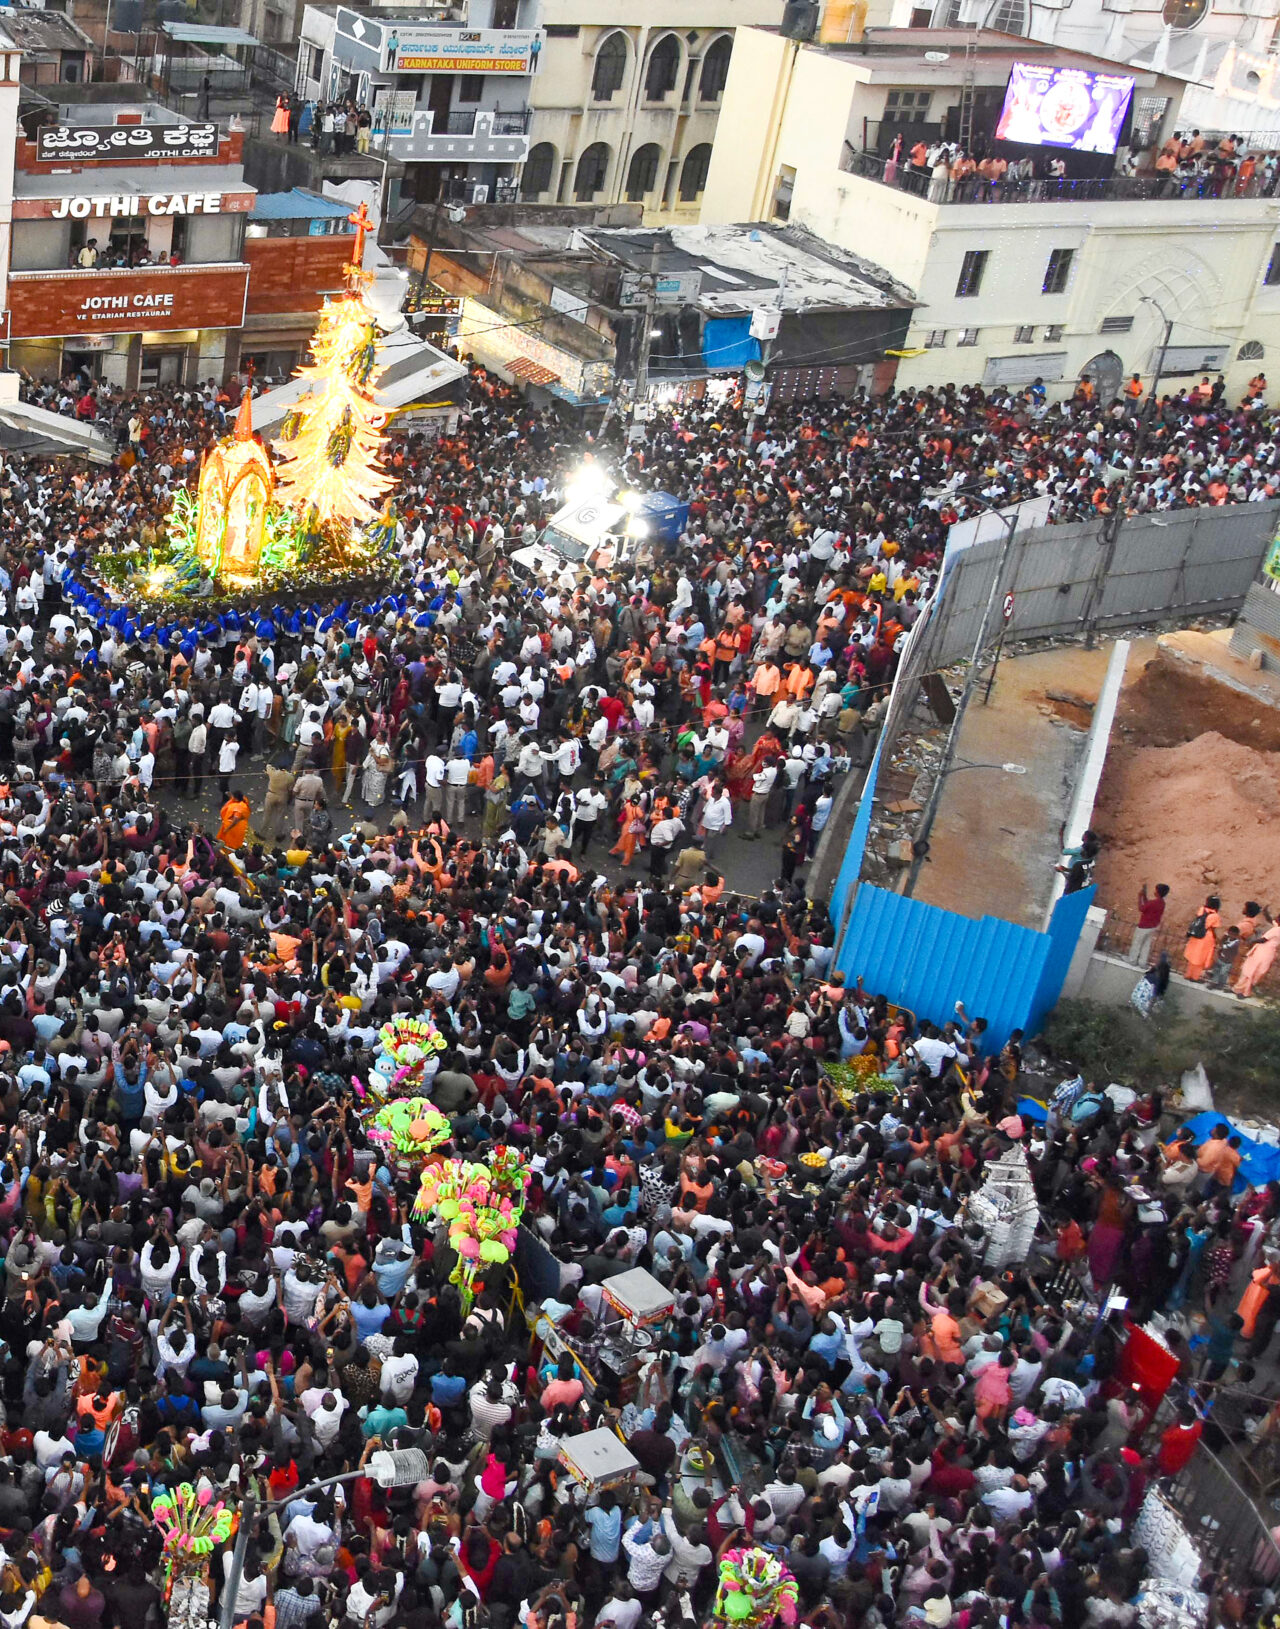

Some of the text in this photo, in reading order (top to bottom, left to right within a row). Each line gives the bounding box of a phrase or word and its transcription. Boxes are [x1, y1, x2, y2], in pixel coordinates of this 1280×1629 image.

[404, 58, 521, 70] KARNATAKA UNIFORM STORE
[42, 127, 154, 150] ಜ್ಯೋತಿ
[144, 149, 179, 157] JOTHI
[51, 193, 222, 218] JOTHI CAFE
[81, 294, 174, 310] JOTHI CAFE
